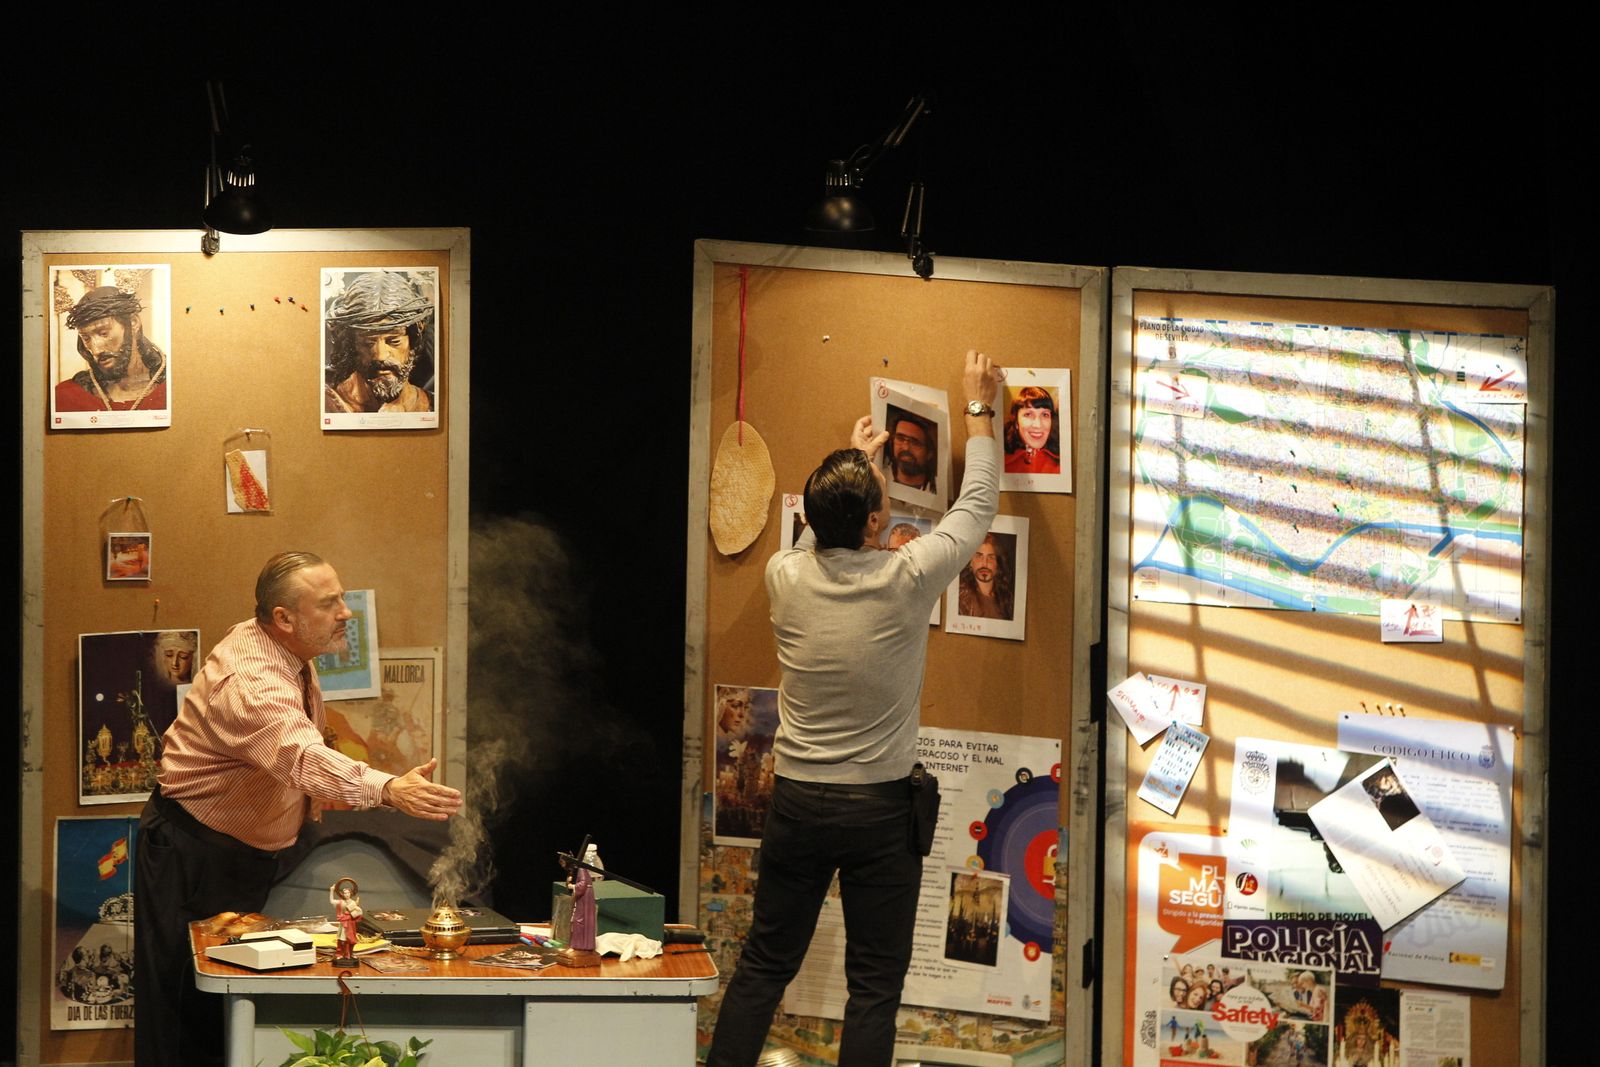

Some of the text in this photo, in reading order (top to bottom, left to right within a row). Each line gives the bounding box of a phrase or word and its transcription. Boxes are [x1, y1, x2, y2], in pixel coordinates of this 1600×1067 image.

[1140, 321, 1160, 330] PLANO
[1162, 323, 1169, 332] DE
[1172, 324, 1179, 332] LA
[1164, 333, 1189, 341] SEVILLA
[384, 665, 425, 683] MALLORCA
[939, 740, 963, 748] PARA
[966, 742, 999, 752] EVITAR
[962, 753, 968, 761] Y
[972, 755, 982, 763] EL
[985, 756, 1004, 765] MAL
[925, 762, 969, 773] INTERNET
[1275, 912, 1315, 921] PREMIO
[1318, 912, 1332, 921] DE
[1335, 912, 1376, 921] NOVEL
[1227, 922, 1373, 953] POLICÍA
[68, 1006, 81, 1021] DIA
[84, 1005, 92, 1020] DE
[95, 1005, 107, 1020] LAS
[1211, 1000, 1279, 1031] Safety
